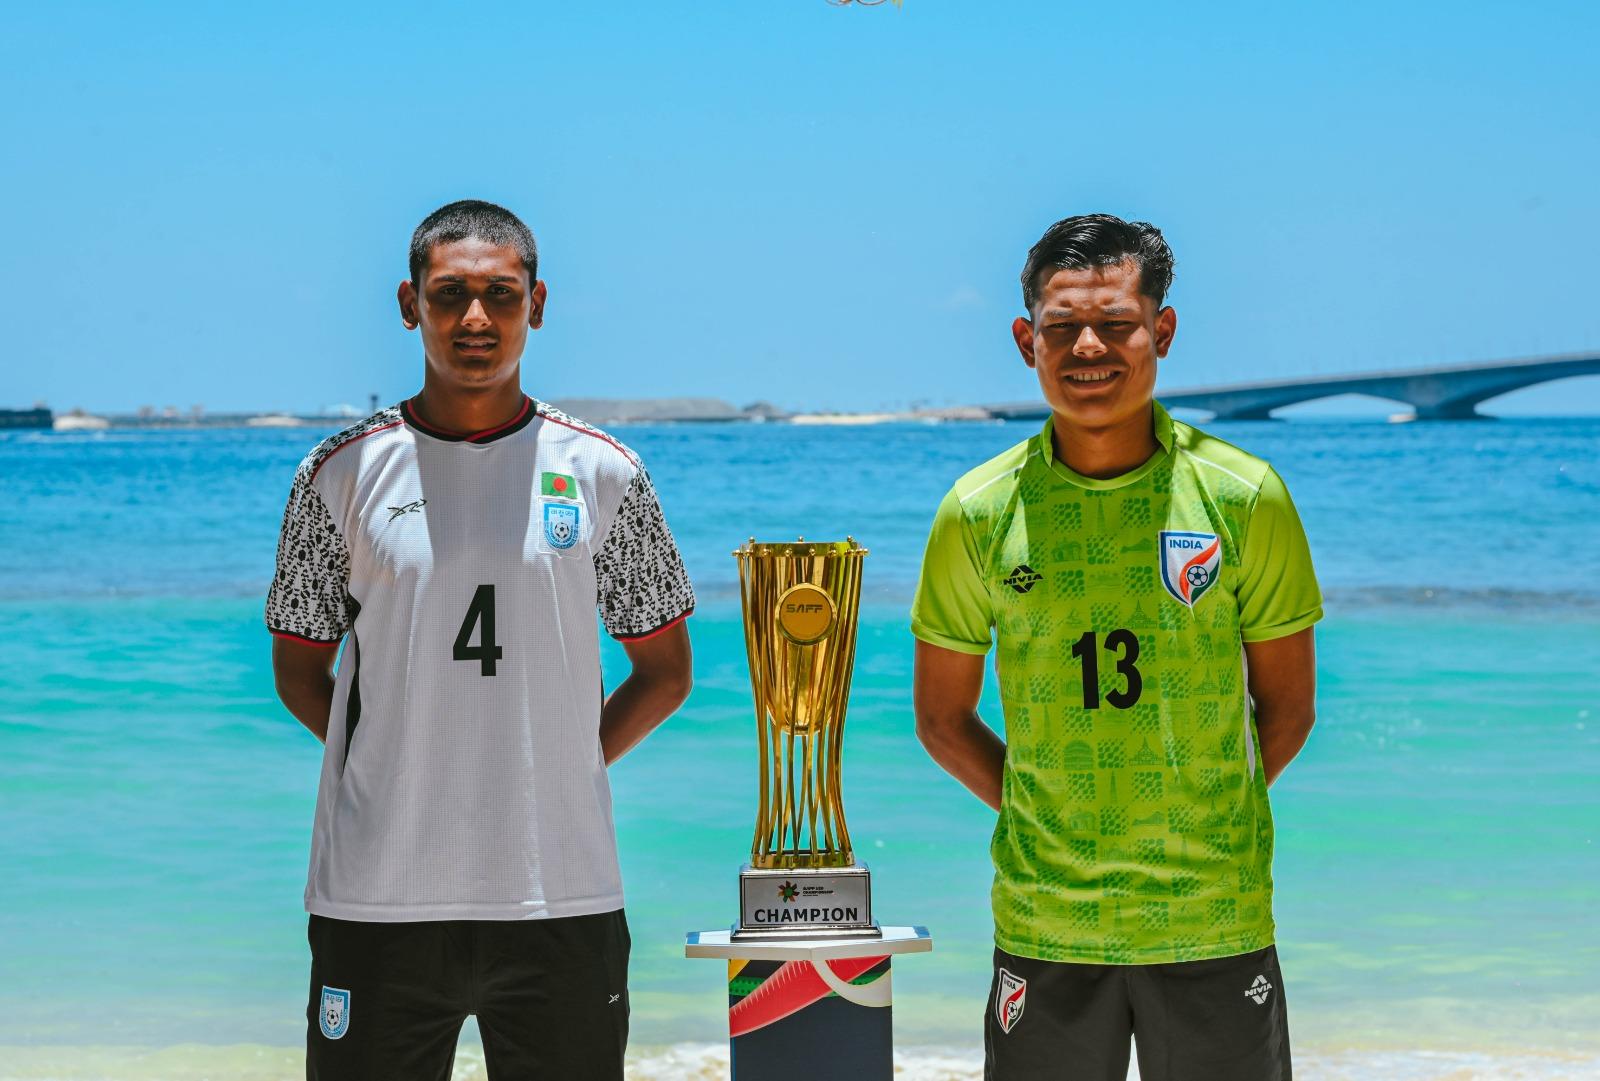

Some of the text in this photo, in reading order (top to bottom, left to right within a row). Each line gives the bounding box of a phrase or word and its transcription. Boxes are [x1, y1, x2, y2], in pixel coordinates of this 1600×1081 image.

[1169, 539, 1203, 549] INDIA
[786, 604, 823, 613] SAFF
[452, 584, 502, 676] 4
[1072, 628, 1143, 709] 13
[754, 907, 858, 922] CHAMPION
[1244, 983, 1273, 997] NIVIA
